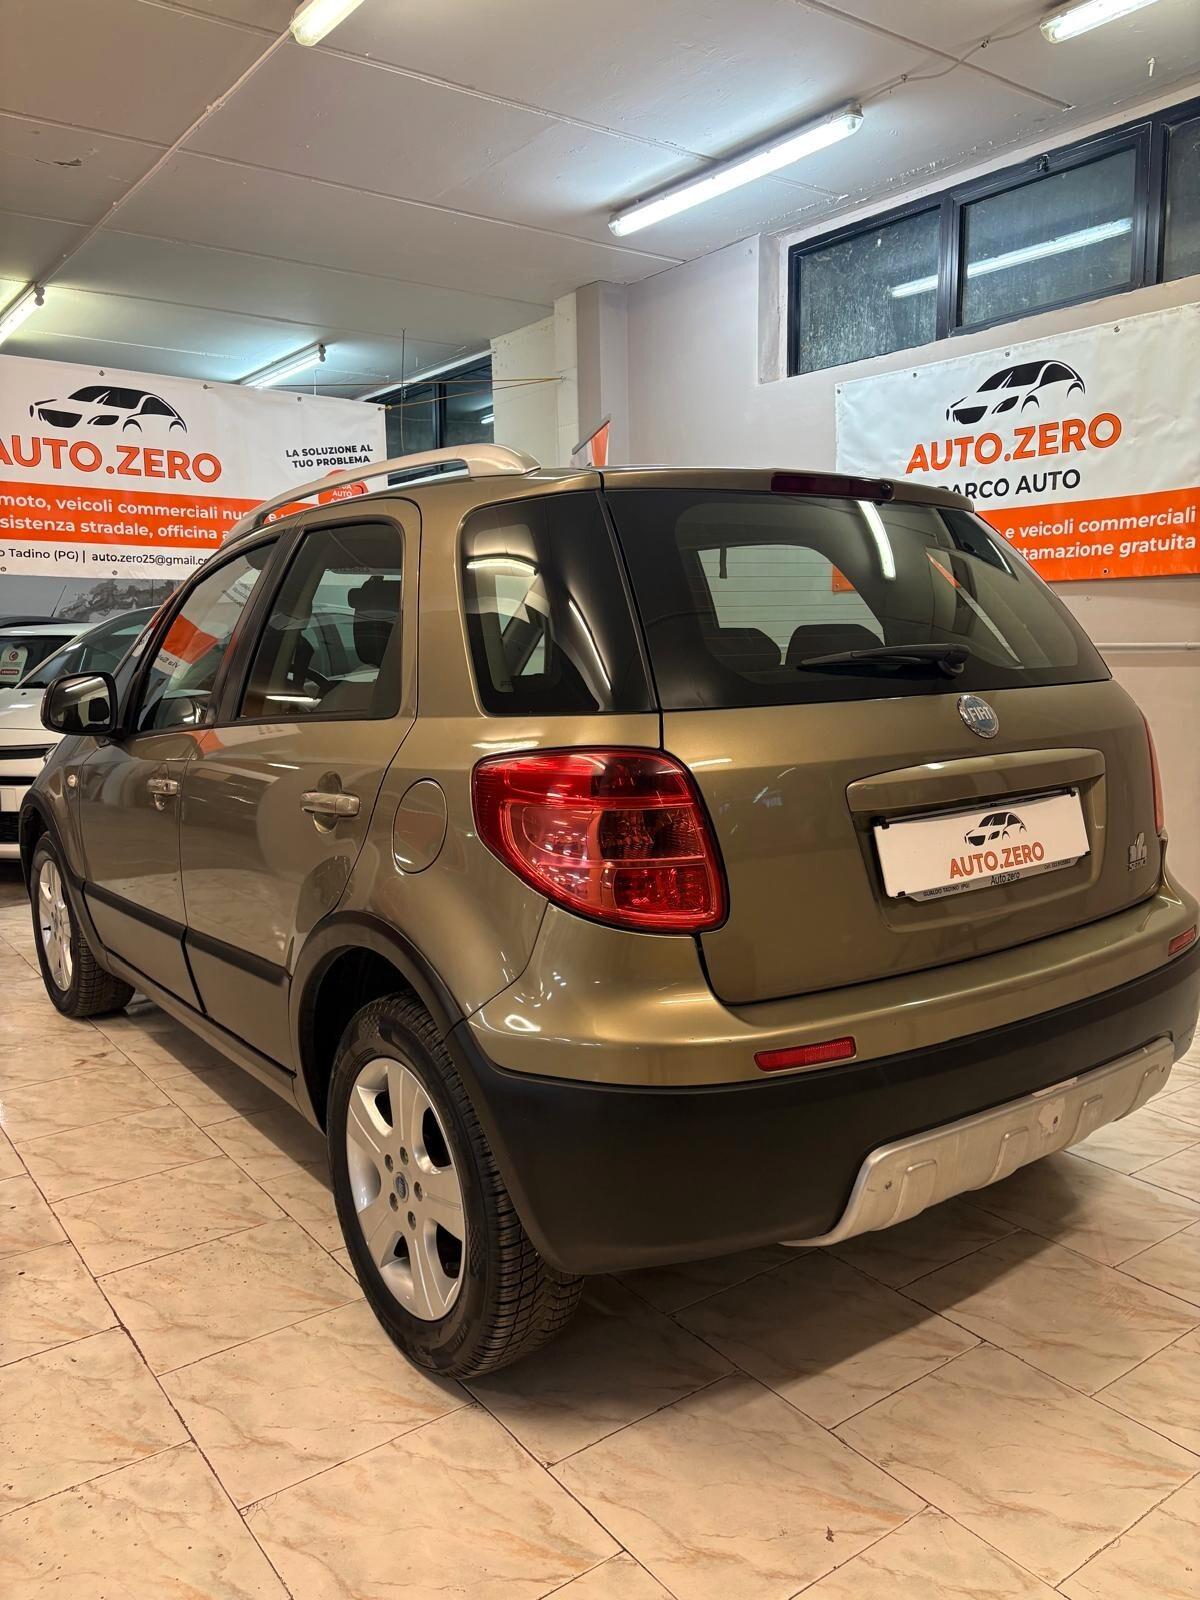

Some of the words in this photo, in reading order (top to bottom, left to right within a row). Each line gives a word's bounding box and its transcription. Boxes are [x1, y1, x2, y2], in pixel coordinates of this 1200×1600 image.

[286, 449, 299, 458] LA
[301, 445, 357, 457] SOLUZIONE
[360, 444, 373, 453] AL
[906, 412, 1122, 474] AUTO.ZERO
[292, 460, 314, 469] TUO
[316, 455, 370, 467] PROBLEMA
[1015, 469, 1081, 495] AUTO
[0, 495, 51, 511] moto,
[56, 497, 113, 512] veicoli
[118, 503, 218, 519] commerciali
[81, 521, 153, 539] stradale,
[158, 525, 217, 539] officina
[1019, 519, 1074, 538] veicoli
[1078, 506, 1196, 533] commerciali
[9, 548, 51, 559] Tadino
[54, 550, 79, 562] (PG)
[1119, 533, 1196, 558] gratuita
[967, 706, 993, 721] FIAT
[950, 841, 1045, 879] AUTO.ZERO
